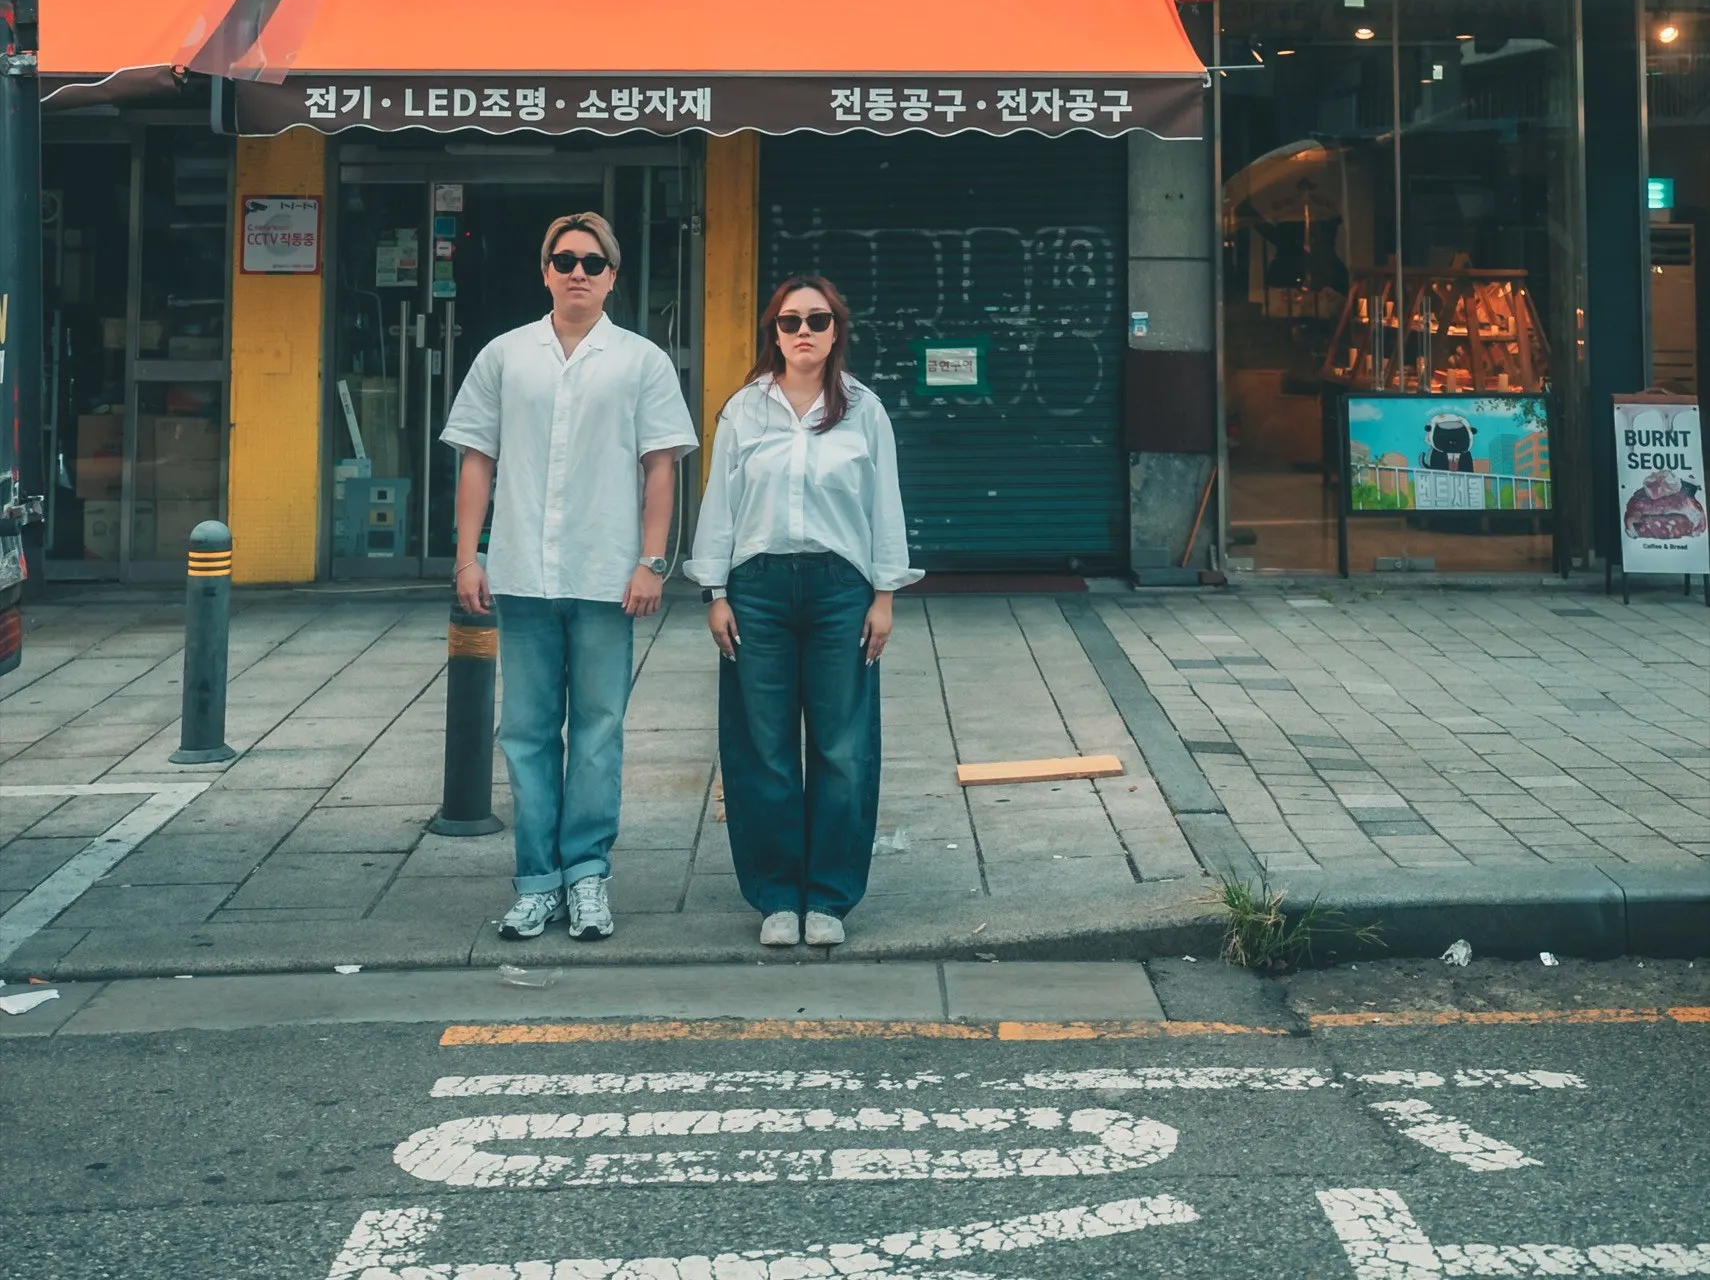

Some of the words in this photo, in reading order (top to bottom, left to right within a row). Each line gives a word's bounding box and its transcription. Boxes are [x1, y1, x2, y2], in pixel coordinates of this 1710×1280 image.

[247, 233, 278, 246] CCTV
[280, 232, 315, 247] 작동중
[1624, 429, 1691, 448] BURNT
[1627, 452, 1693, 471] SEOUL
